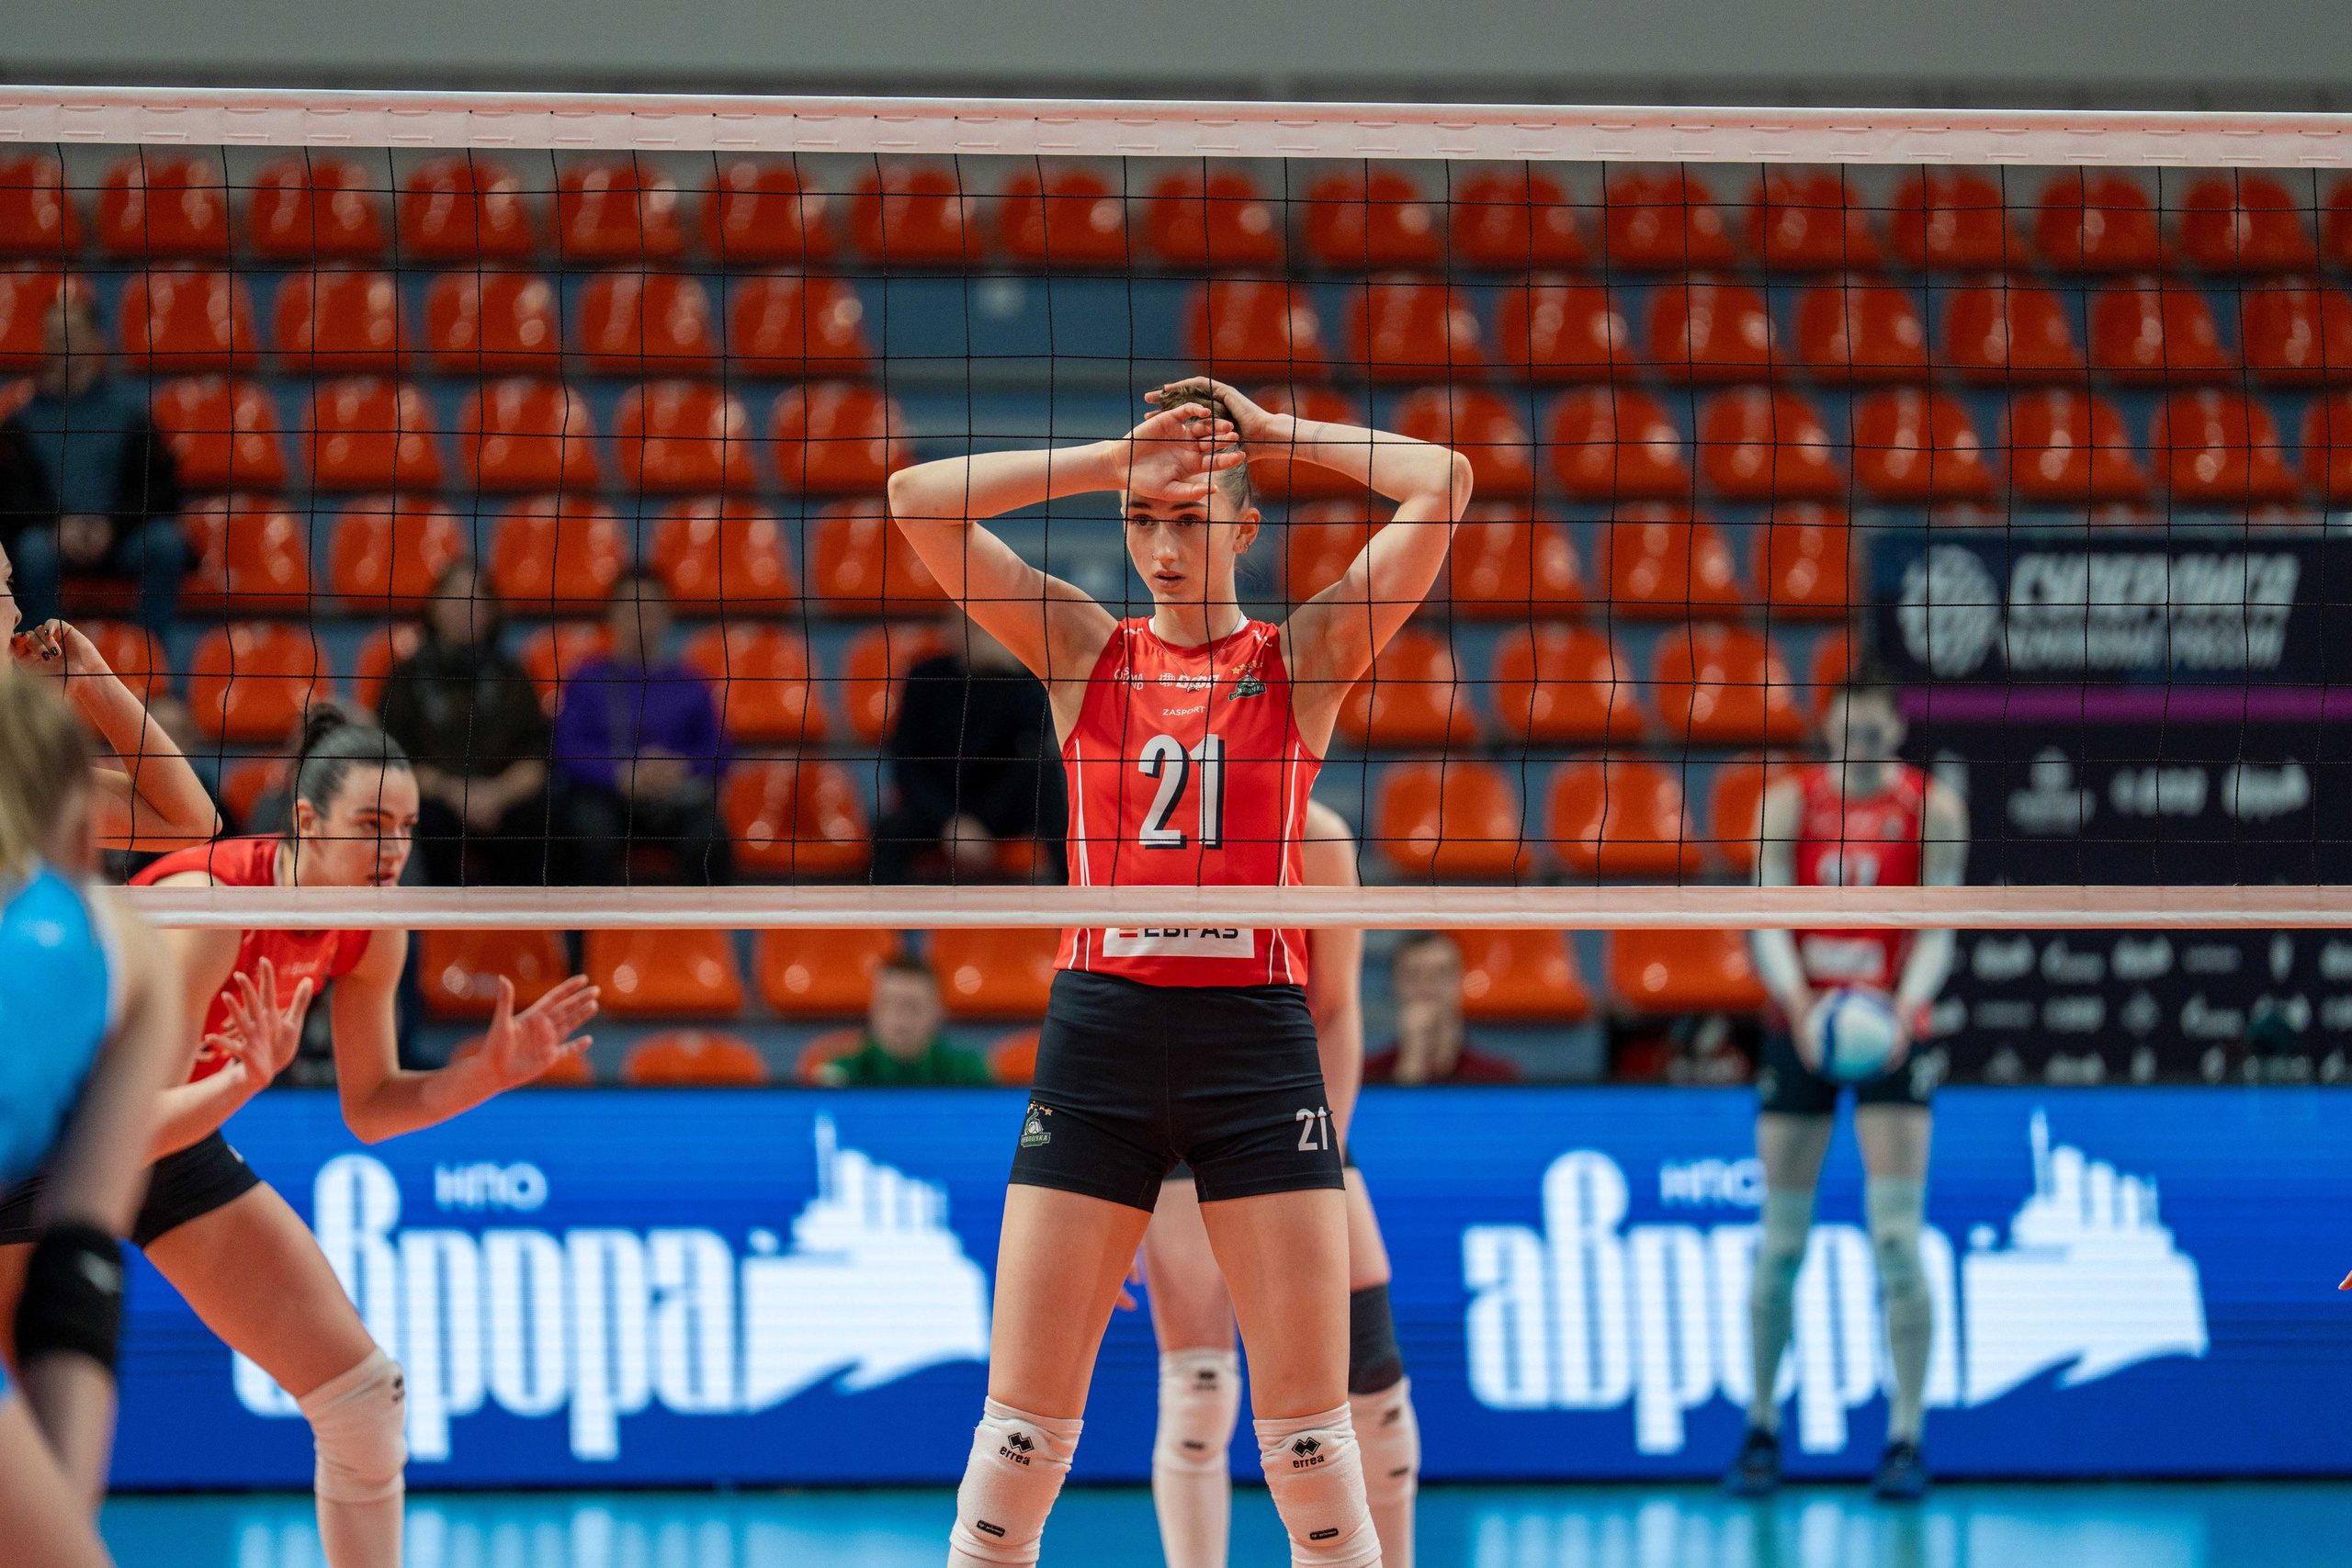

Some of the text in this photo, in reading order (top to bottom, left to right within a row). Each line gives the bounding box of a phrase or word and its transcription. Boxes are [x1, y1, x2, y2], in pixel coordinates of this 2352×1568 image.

[1162, 705, 1205, 716] ZASPORT
[1138, 733, 1225, 850] 21
[1295, 1106, 1329, 1151] 21
